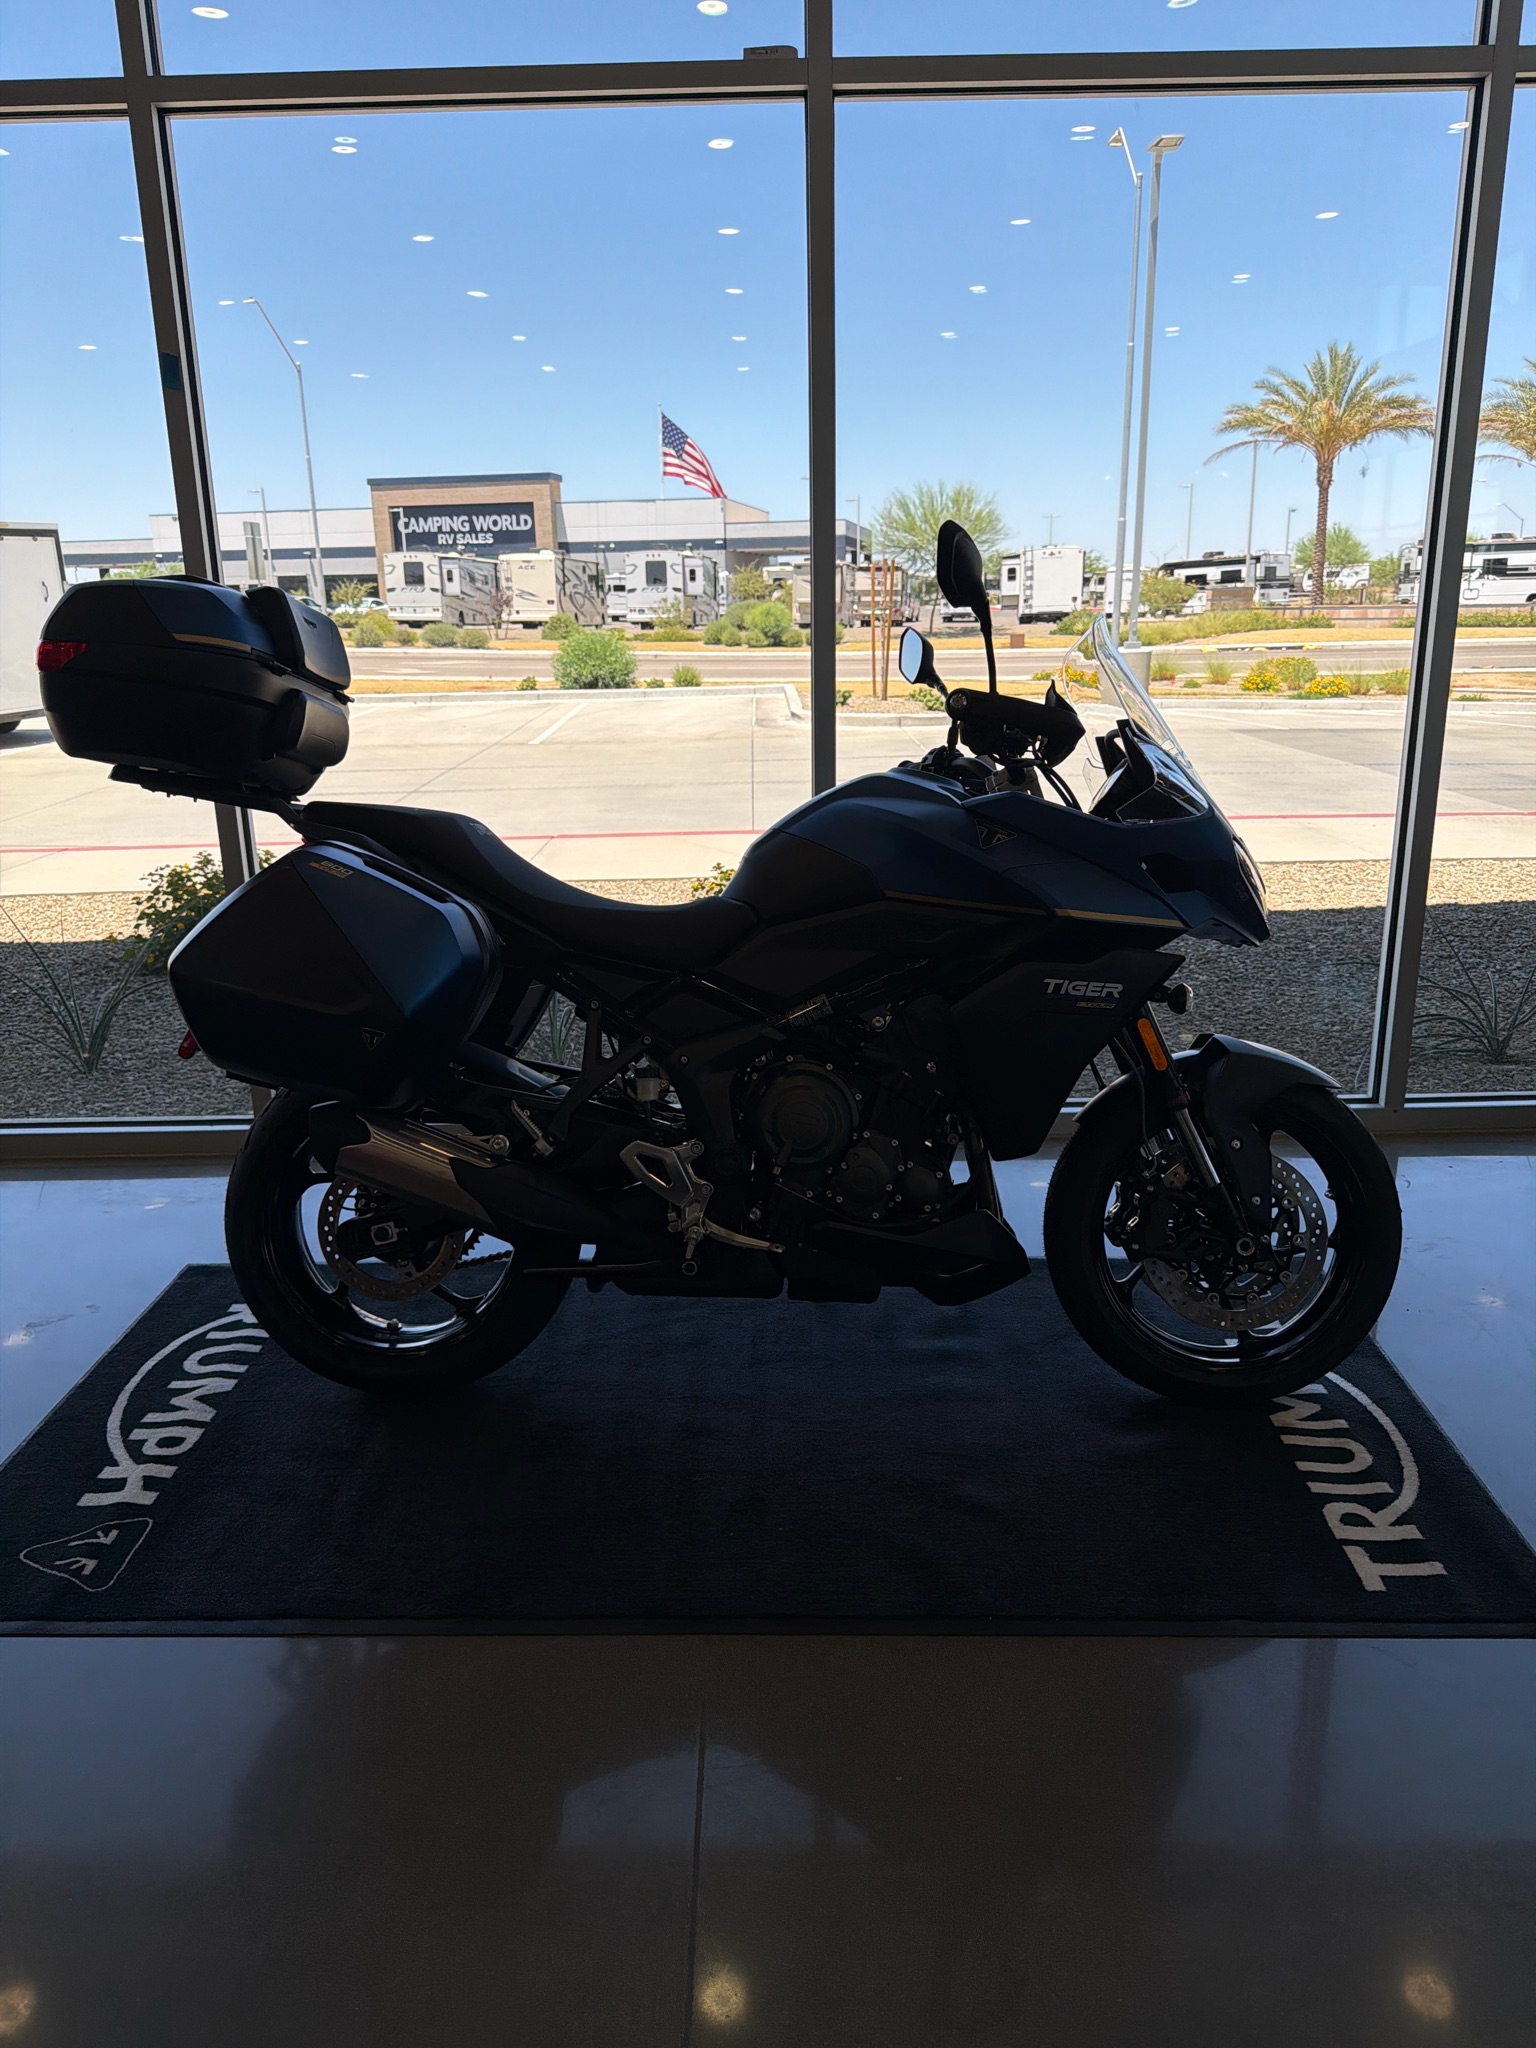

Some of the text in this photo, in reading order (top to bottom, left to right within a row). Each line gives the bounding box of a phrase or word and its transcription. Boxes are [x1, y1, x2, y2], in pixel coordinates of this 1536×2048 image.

[398, 514, 533, 533] CAMPING WORLD
[437, 533, 494, 545] RV SALES
[1043, 978, 1124, 998] TIGER
[77, 1303, 270, 1506] IUMPH
[1269, 1375, 1448, 1592] TRIUM
